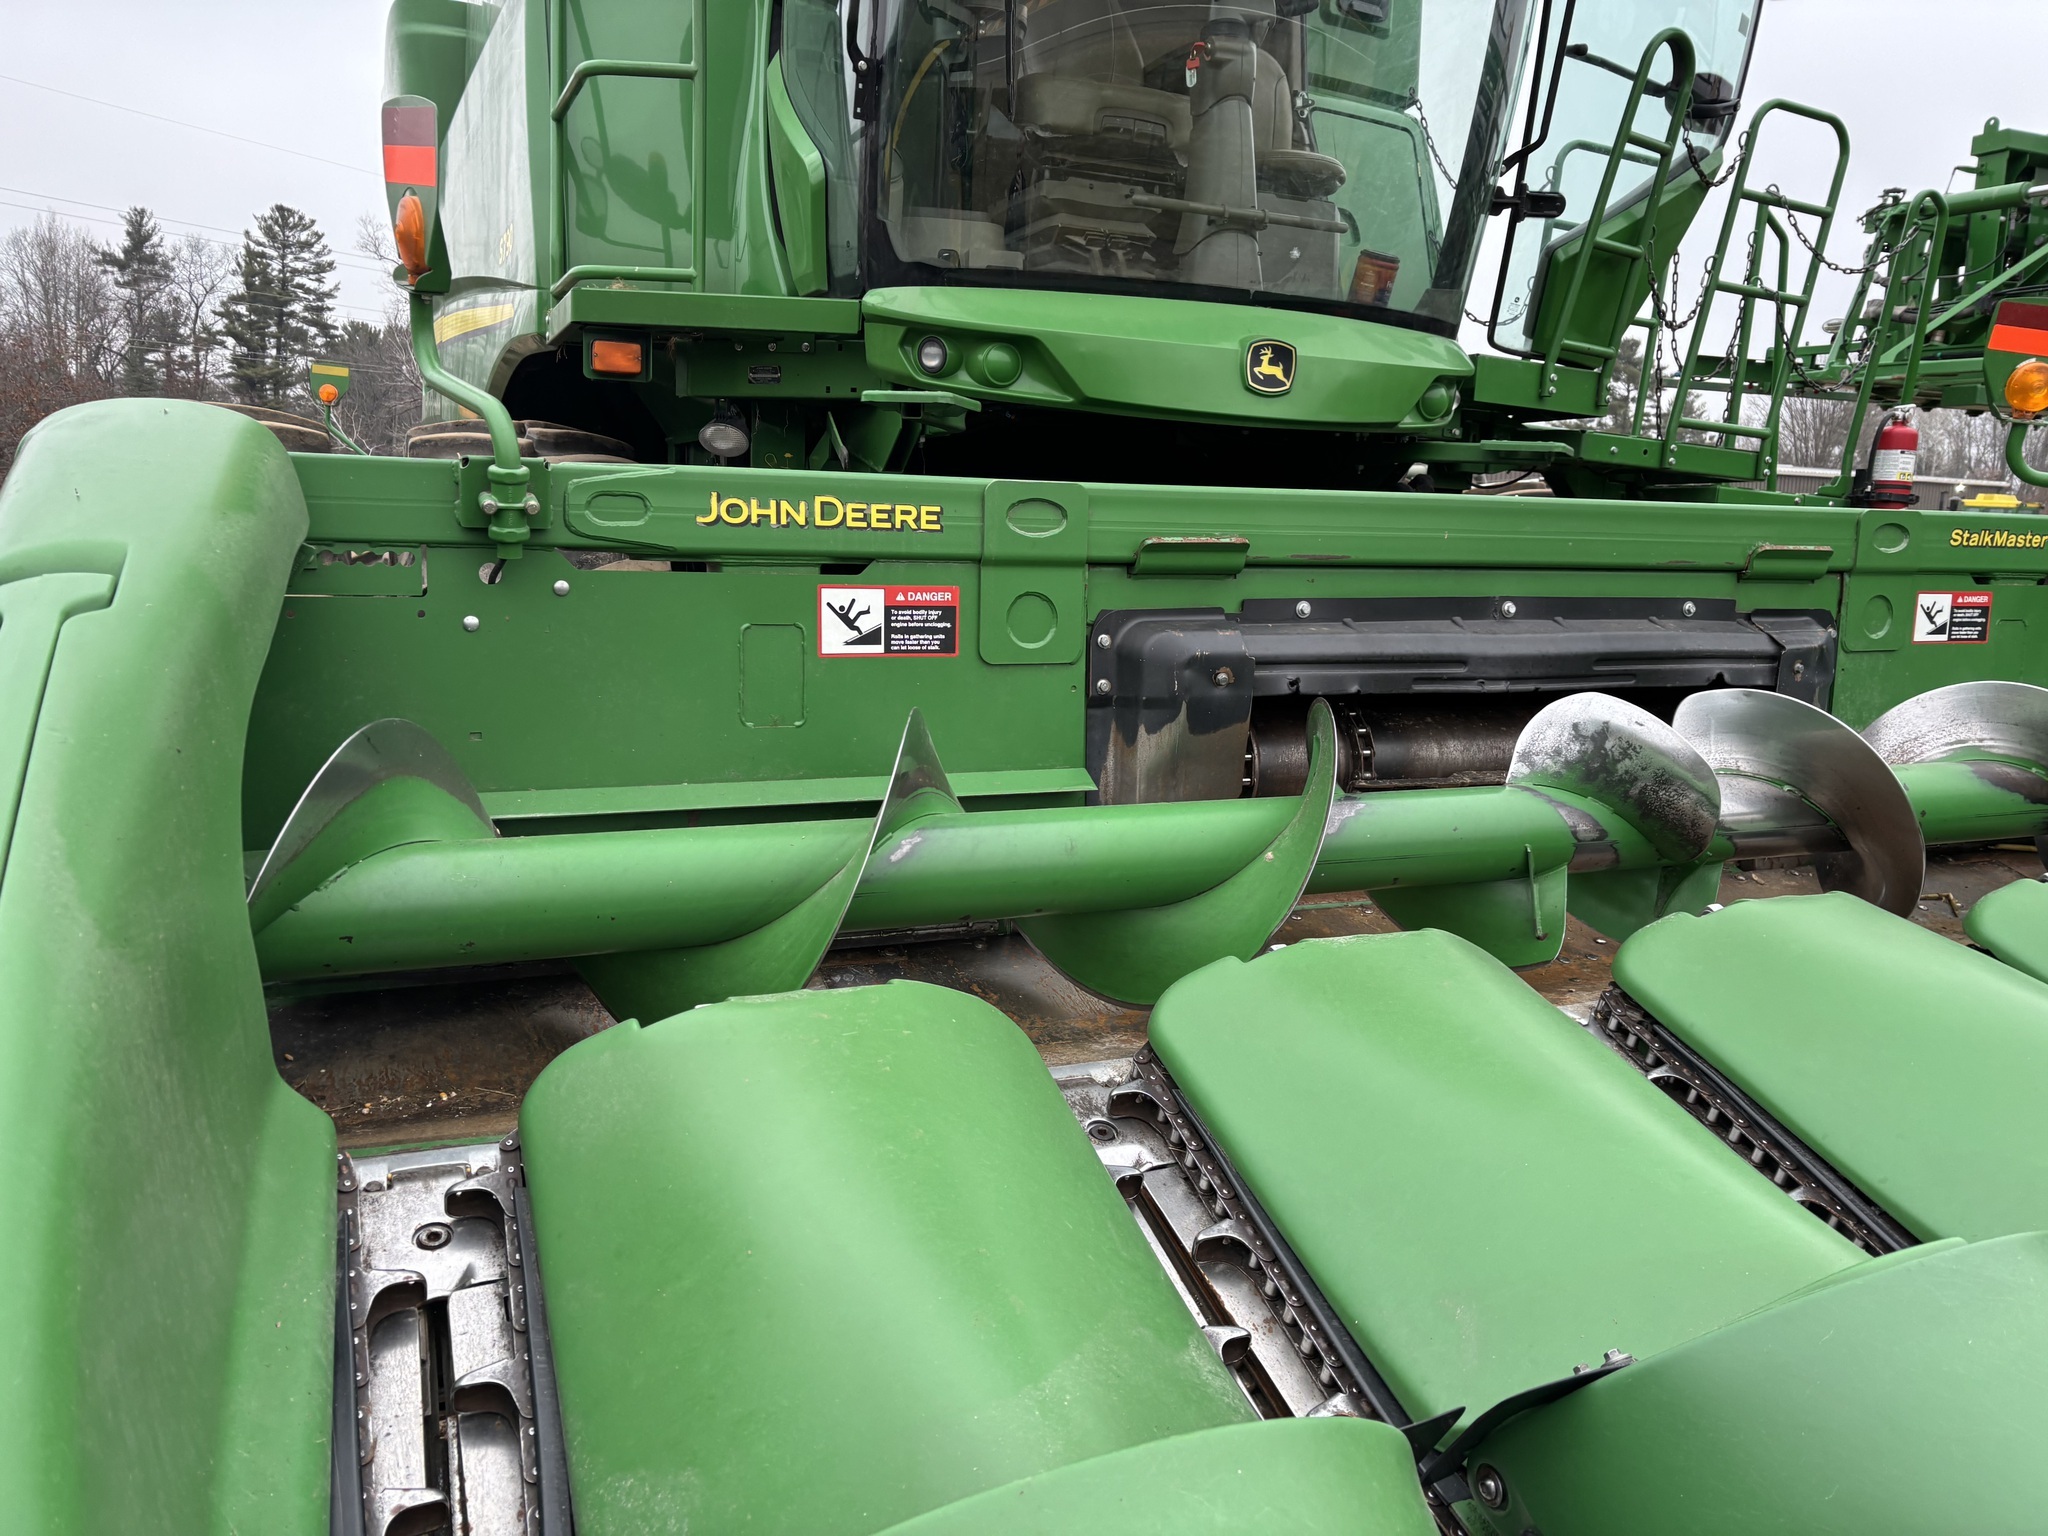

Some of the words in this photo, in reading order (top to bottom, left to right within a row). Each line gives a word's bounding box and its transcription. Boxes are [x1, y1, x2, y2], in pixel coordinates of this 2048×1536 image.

[696, 491, 809, 528] JOHN
[814, 495, 943, 532] DEERE
[1950, 528, 2048, 549] StalkMaster
[908, 592, 952, 601] DANGER
